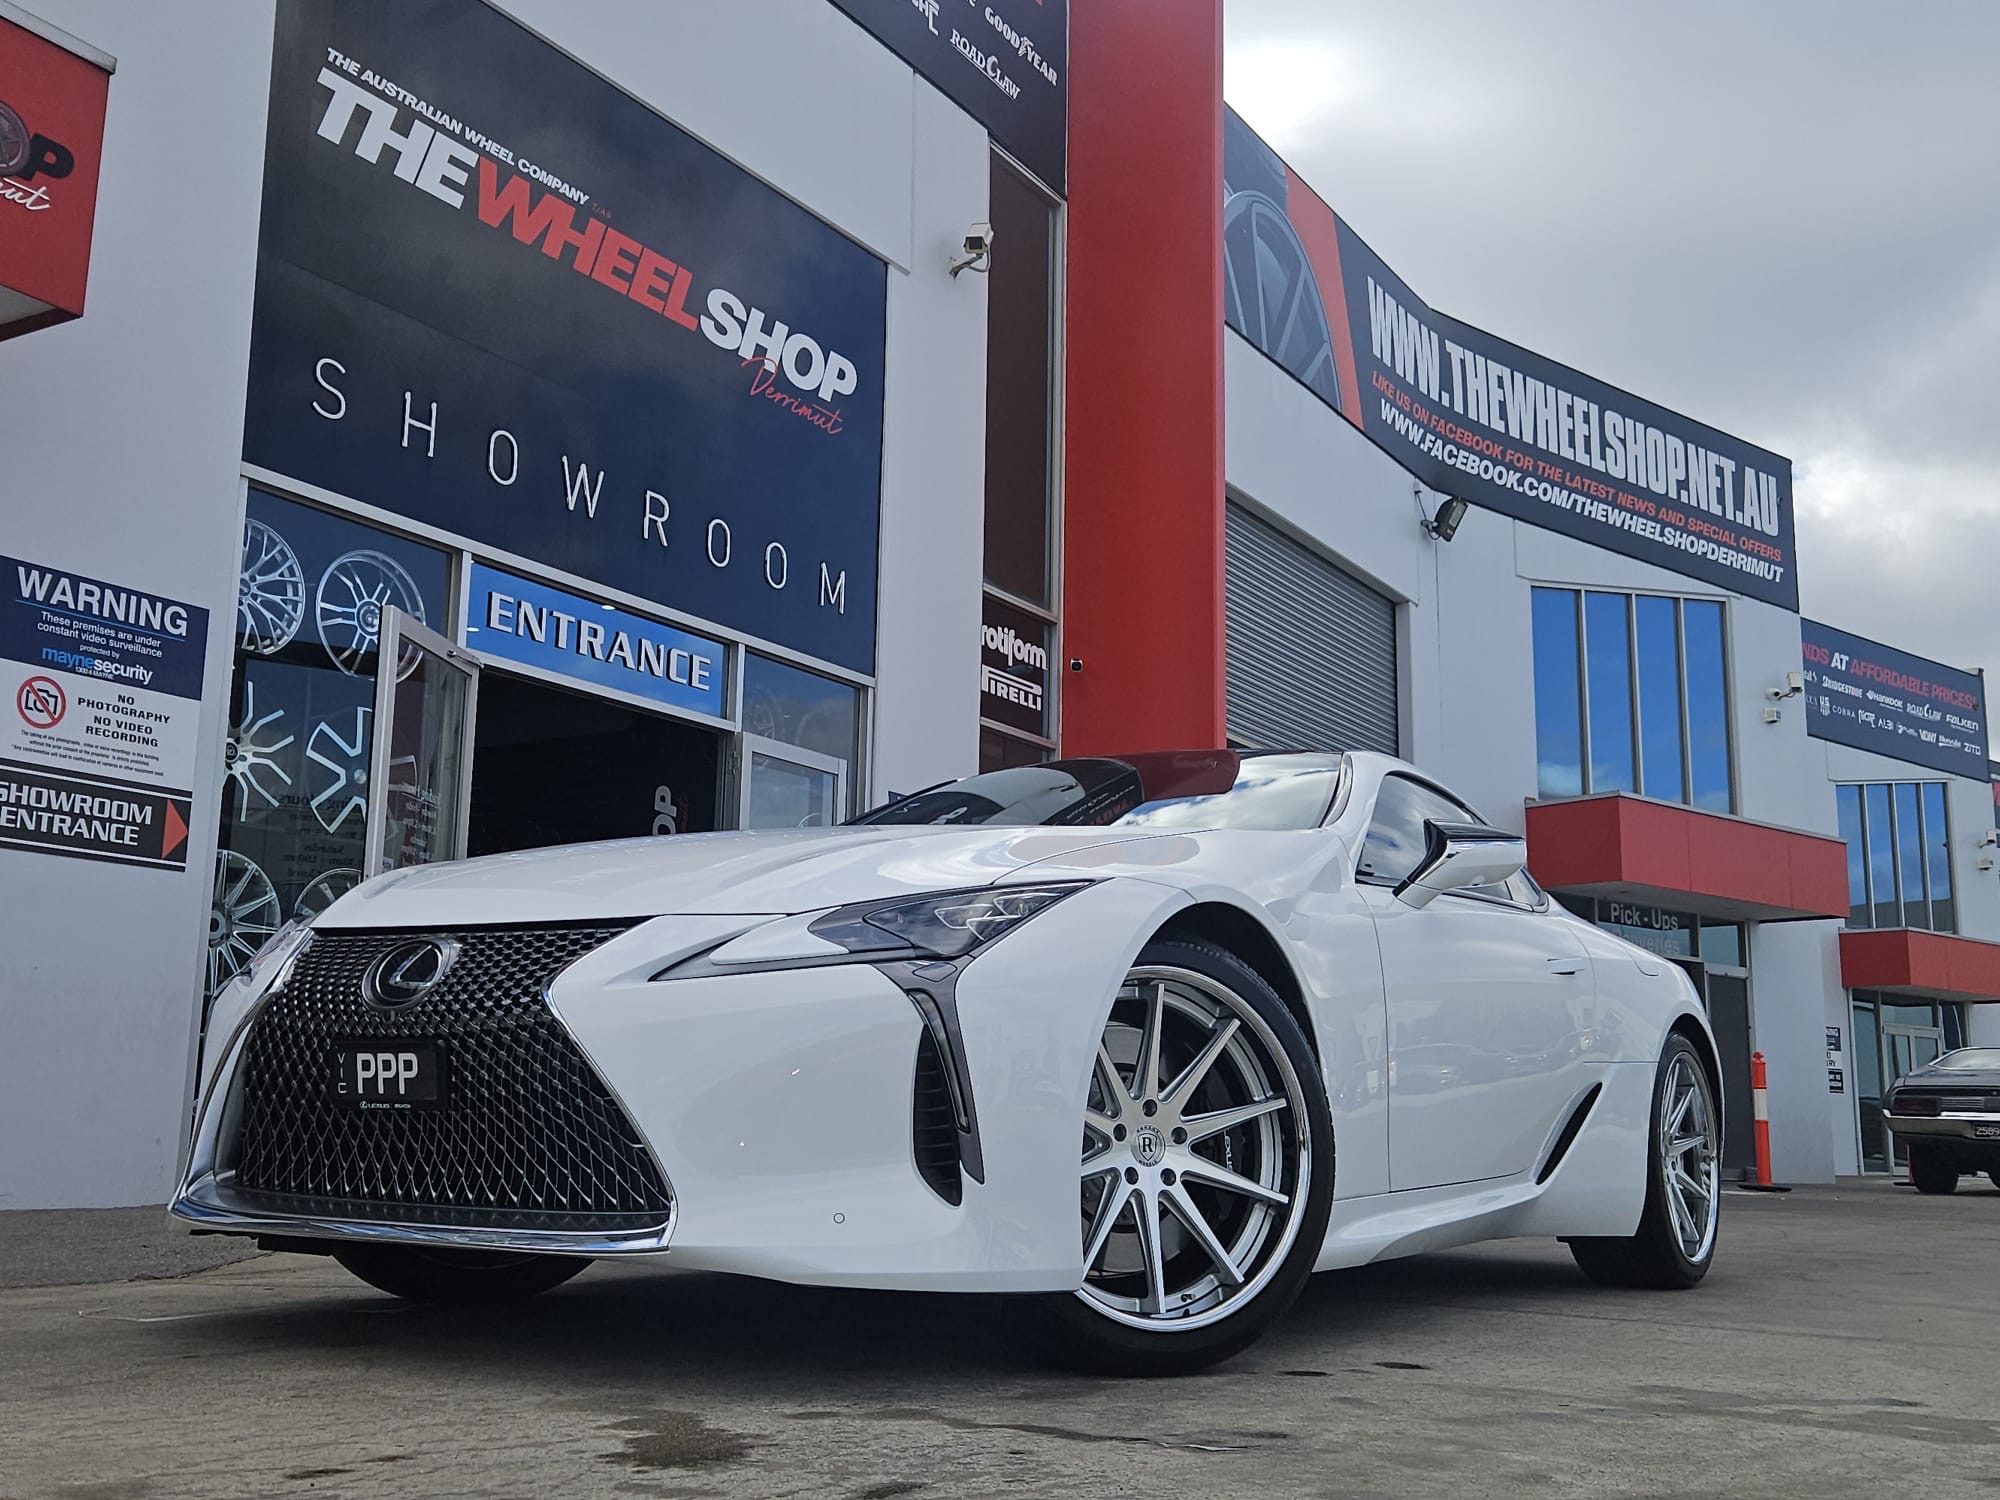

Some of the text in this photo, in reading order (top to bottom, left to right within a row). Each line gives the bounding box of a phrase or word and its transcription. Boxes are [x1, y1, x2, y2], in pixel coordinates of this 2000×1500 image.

[949, 28, 1021, 100] ROADCLAW
[985, 6, 1058, 87] GOODYEAR
[327, 47, 361, 77] THE
[360, 69, 463, 135] AUSTRALIAN
[465, 126, 515, 166] WHEEL
[517, 158, 590, 205] COMPANY
[741, 357, 843, 434] Derrimut
[1367, 275, 1779, 538] WWW.THEWHEELSHOP.NET.AU
[312, 358, 847, 615] SHOWROOM
[1372, 370, 1782, 562] LIKE US ON FACEBOOK FOR THE LATEST NEWS AND SPECIAL OFFERS
[1380, 398, 1784, 583] WWW.FACEBOOK.COM/THEWHEELSHOPDERRIMUT
[17, 566, 188, 637] WARNING
[37, 622, 162, 658] constant video surveillance
[41, 611, 161, 648] These premises are under
[80, 644, 120, 659] protected by
[487, 591, 711, 692] ENTRANCE
[981, 624, 1047, 671] rotiform
[981, 663, 1042, 711] PIRELLI
[1831, 651, 1849, 671] AT
[1850, 658, 1930, 697] AFFORDABLE
[77, 697, 170, 724] PHOTOGRAPHY
[118, 694, 135, 705] NO
[86, 725, 158, 747] RECORDING
[94, 715, 153, 735] NO VIDEO
[0, 781, 153, 825] SHOWROOM
[0, 806, 140, 846] ENTRANCE
[1610, 903, 1641, 926] Pick
[1651, 908, 1679, 931] Ups
[356, 1052, 418, 1095] PPP
[1142, 1136, 1154, 1153] R
